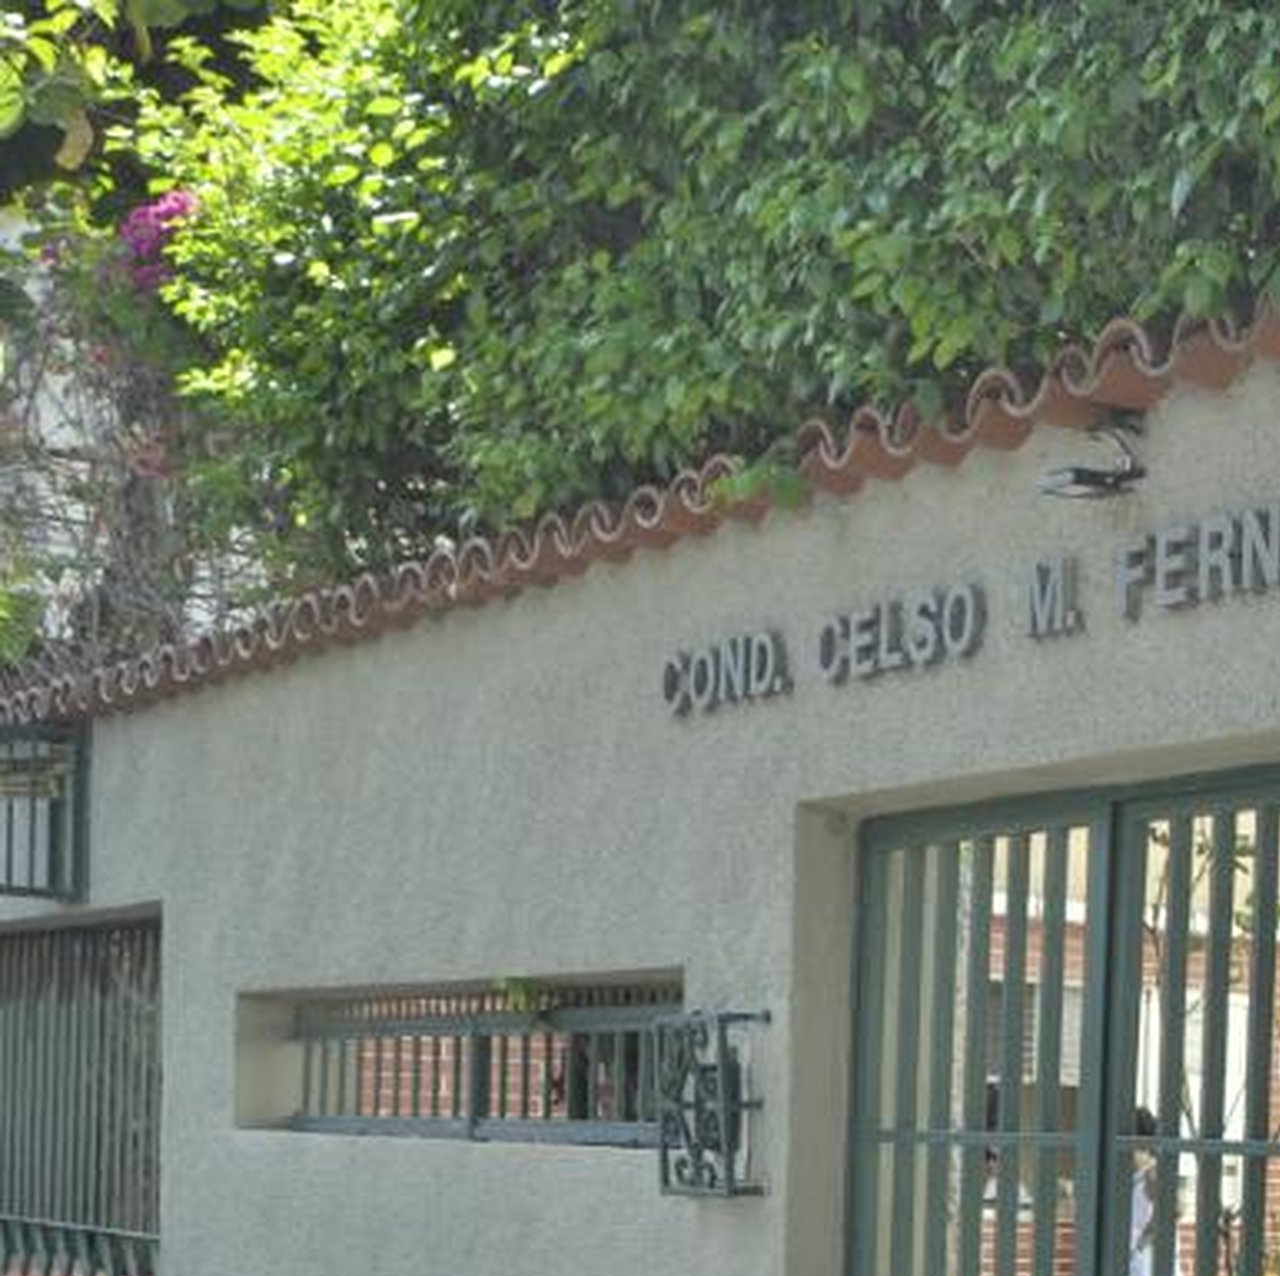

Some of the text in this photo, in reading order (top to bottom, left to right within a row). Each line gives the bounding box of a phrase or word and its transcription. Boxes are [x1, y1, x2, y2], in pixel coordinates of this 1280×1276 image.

[663, 633, 792, 716] COND.
[816, 583, 985, 683] CELSO
[1028, 558, 1084, 638] M.
